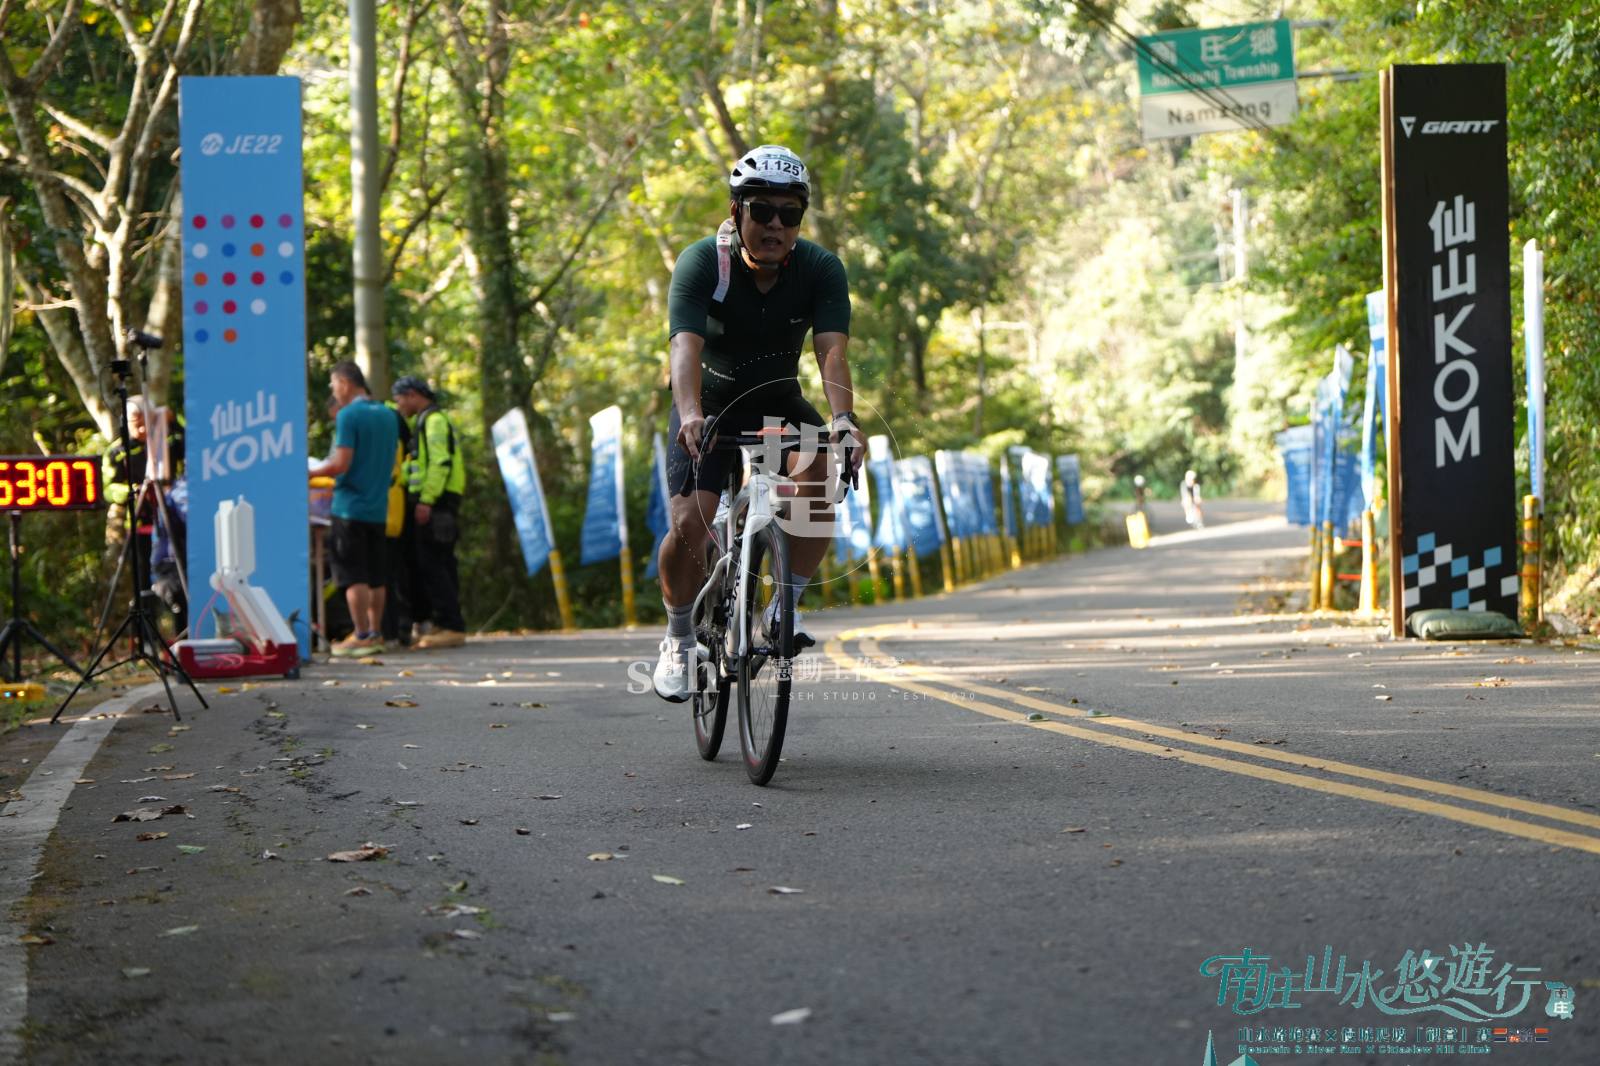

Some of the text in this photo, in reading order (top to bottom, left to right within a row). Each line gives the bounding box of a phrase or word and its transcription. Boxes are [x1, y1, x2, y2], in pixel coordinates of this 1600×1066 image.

[1222, 62, 1280, 82] Township
[225, 134, 283, 155] JE22
[1421, 119, 1499, 134] GIANT
[1428, 194, 1481, 468] 仙山 KOM
[209, 389, 277, 441] 仙山
[201, 421, 293, 482] KOM
